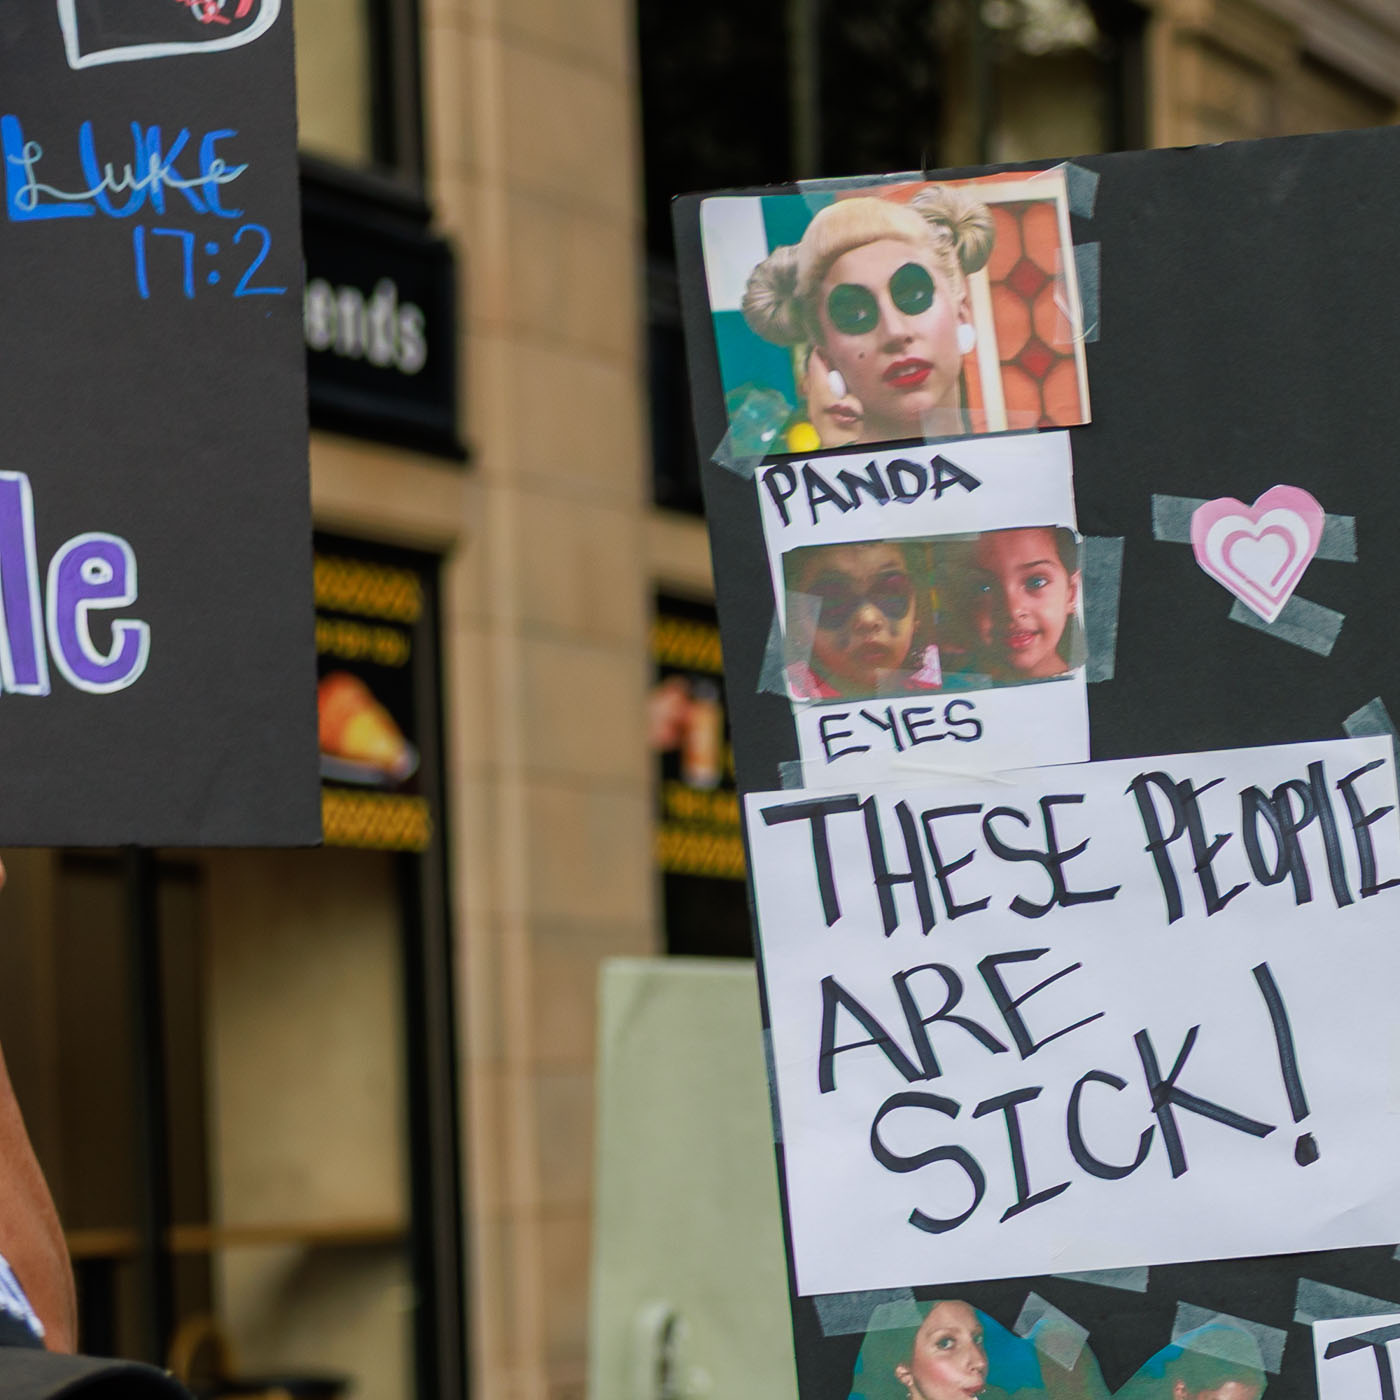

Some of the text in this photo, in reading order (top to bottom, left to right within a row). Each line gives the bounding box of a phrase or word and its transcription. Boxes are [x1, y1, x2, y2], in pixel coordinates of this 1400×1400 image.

[133, 225, 288, 299] 17:2
[761, 455, 981, 528] PANDA
[819, 700, 983, 764] EYES
[760, 794, 1122, 937] THESE
[818, 948, 1105, 1093] ARE
[870, 961, 1320, 1233] SICK!
